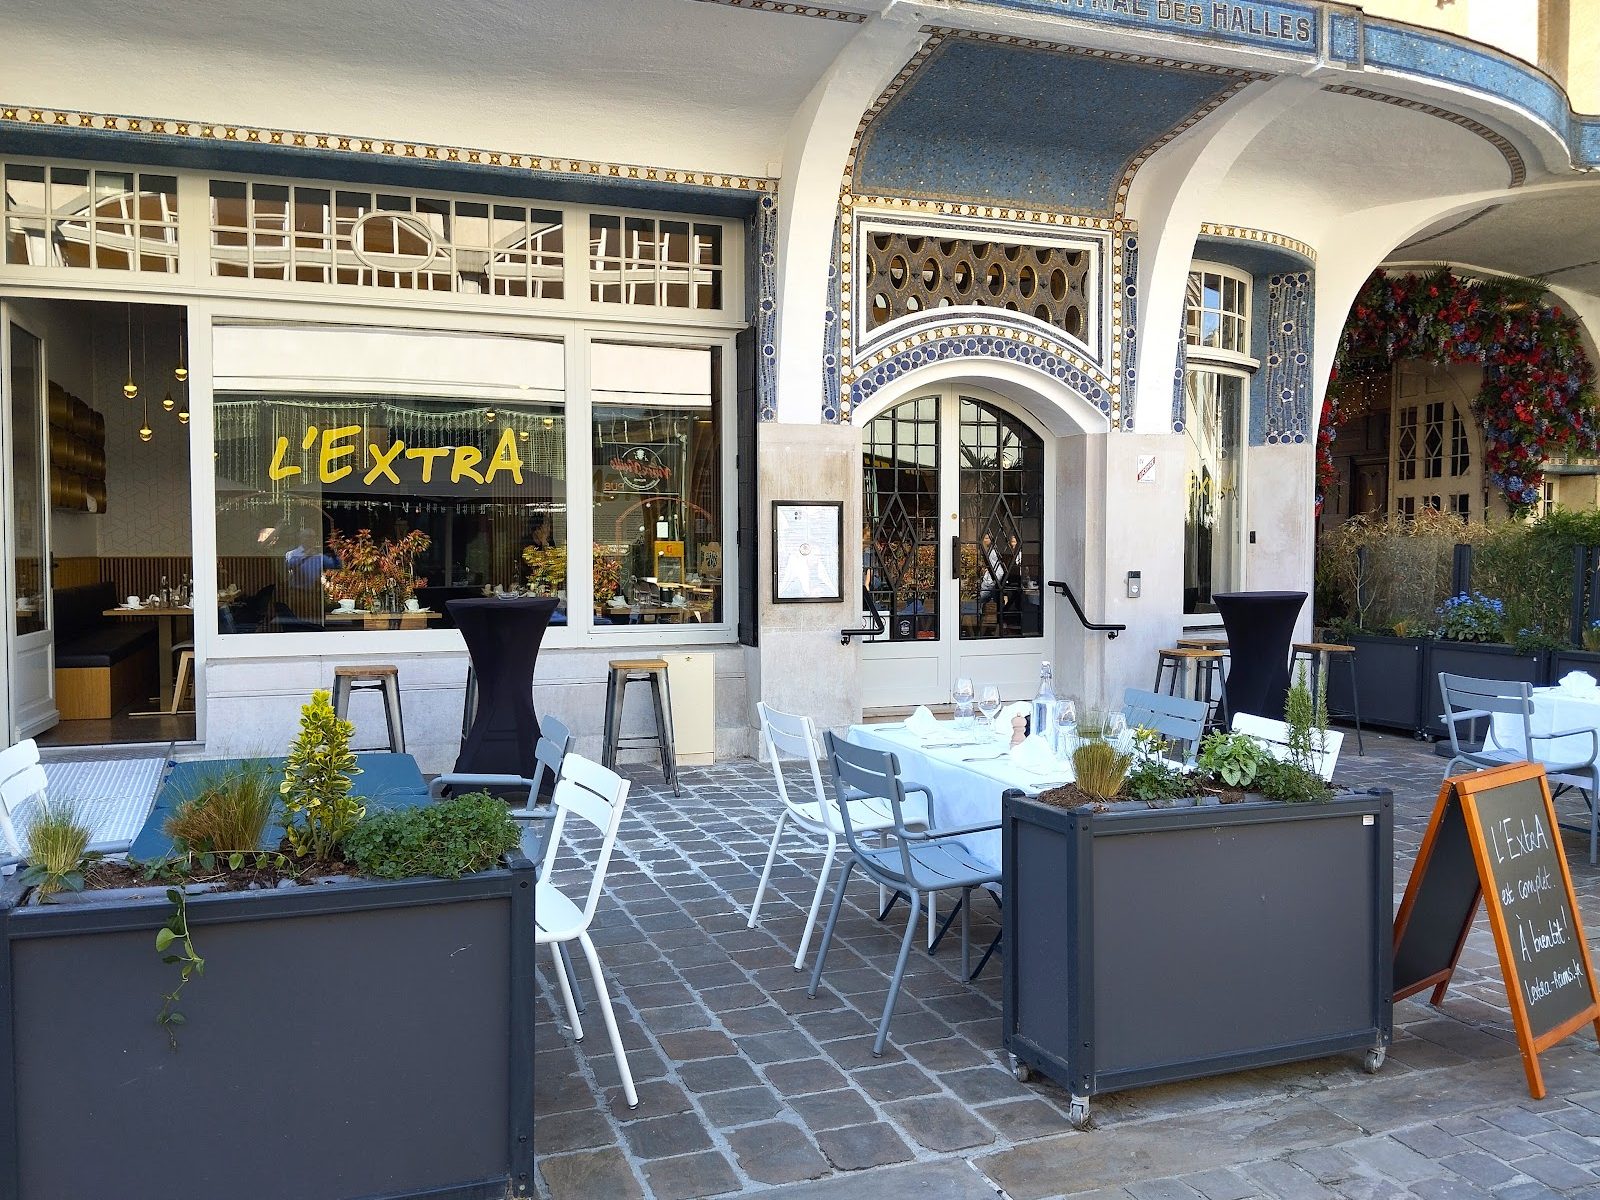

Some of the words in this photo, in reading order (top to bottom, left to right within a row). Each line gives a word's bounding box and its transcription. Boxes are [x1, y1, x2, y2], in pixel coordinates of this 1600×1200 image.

[1158, 0, 1203, 25] DES
[1212, 2, 1311, 42] HALLES
[1502, 882, 1514, 905] est
[1516, 914, 1532, 962] À
